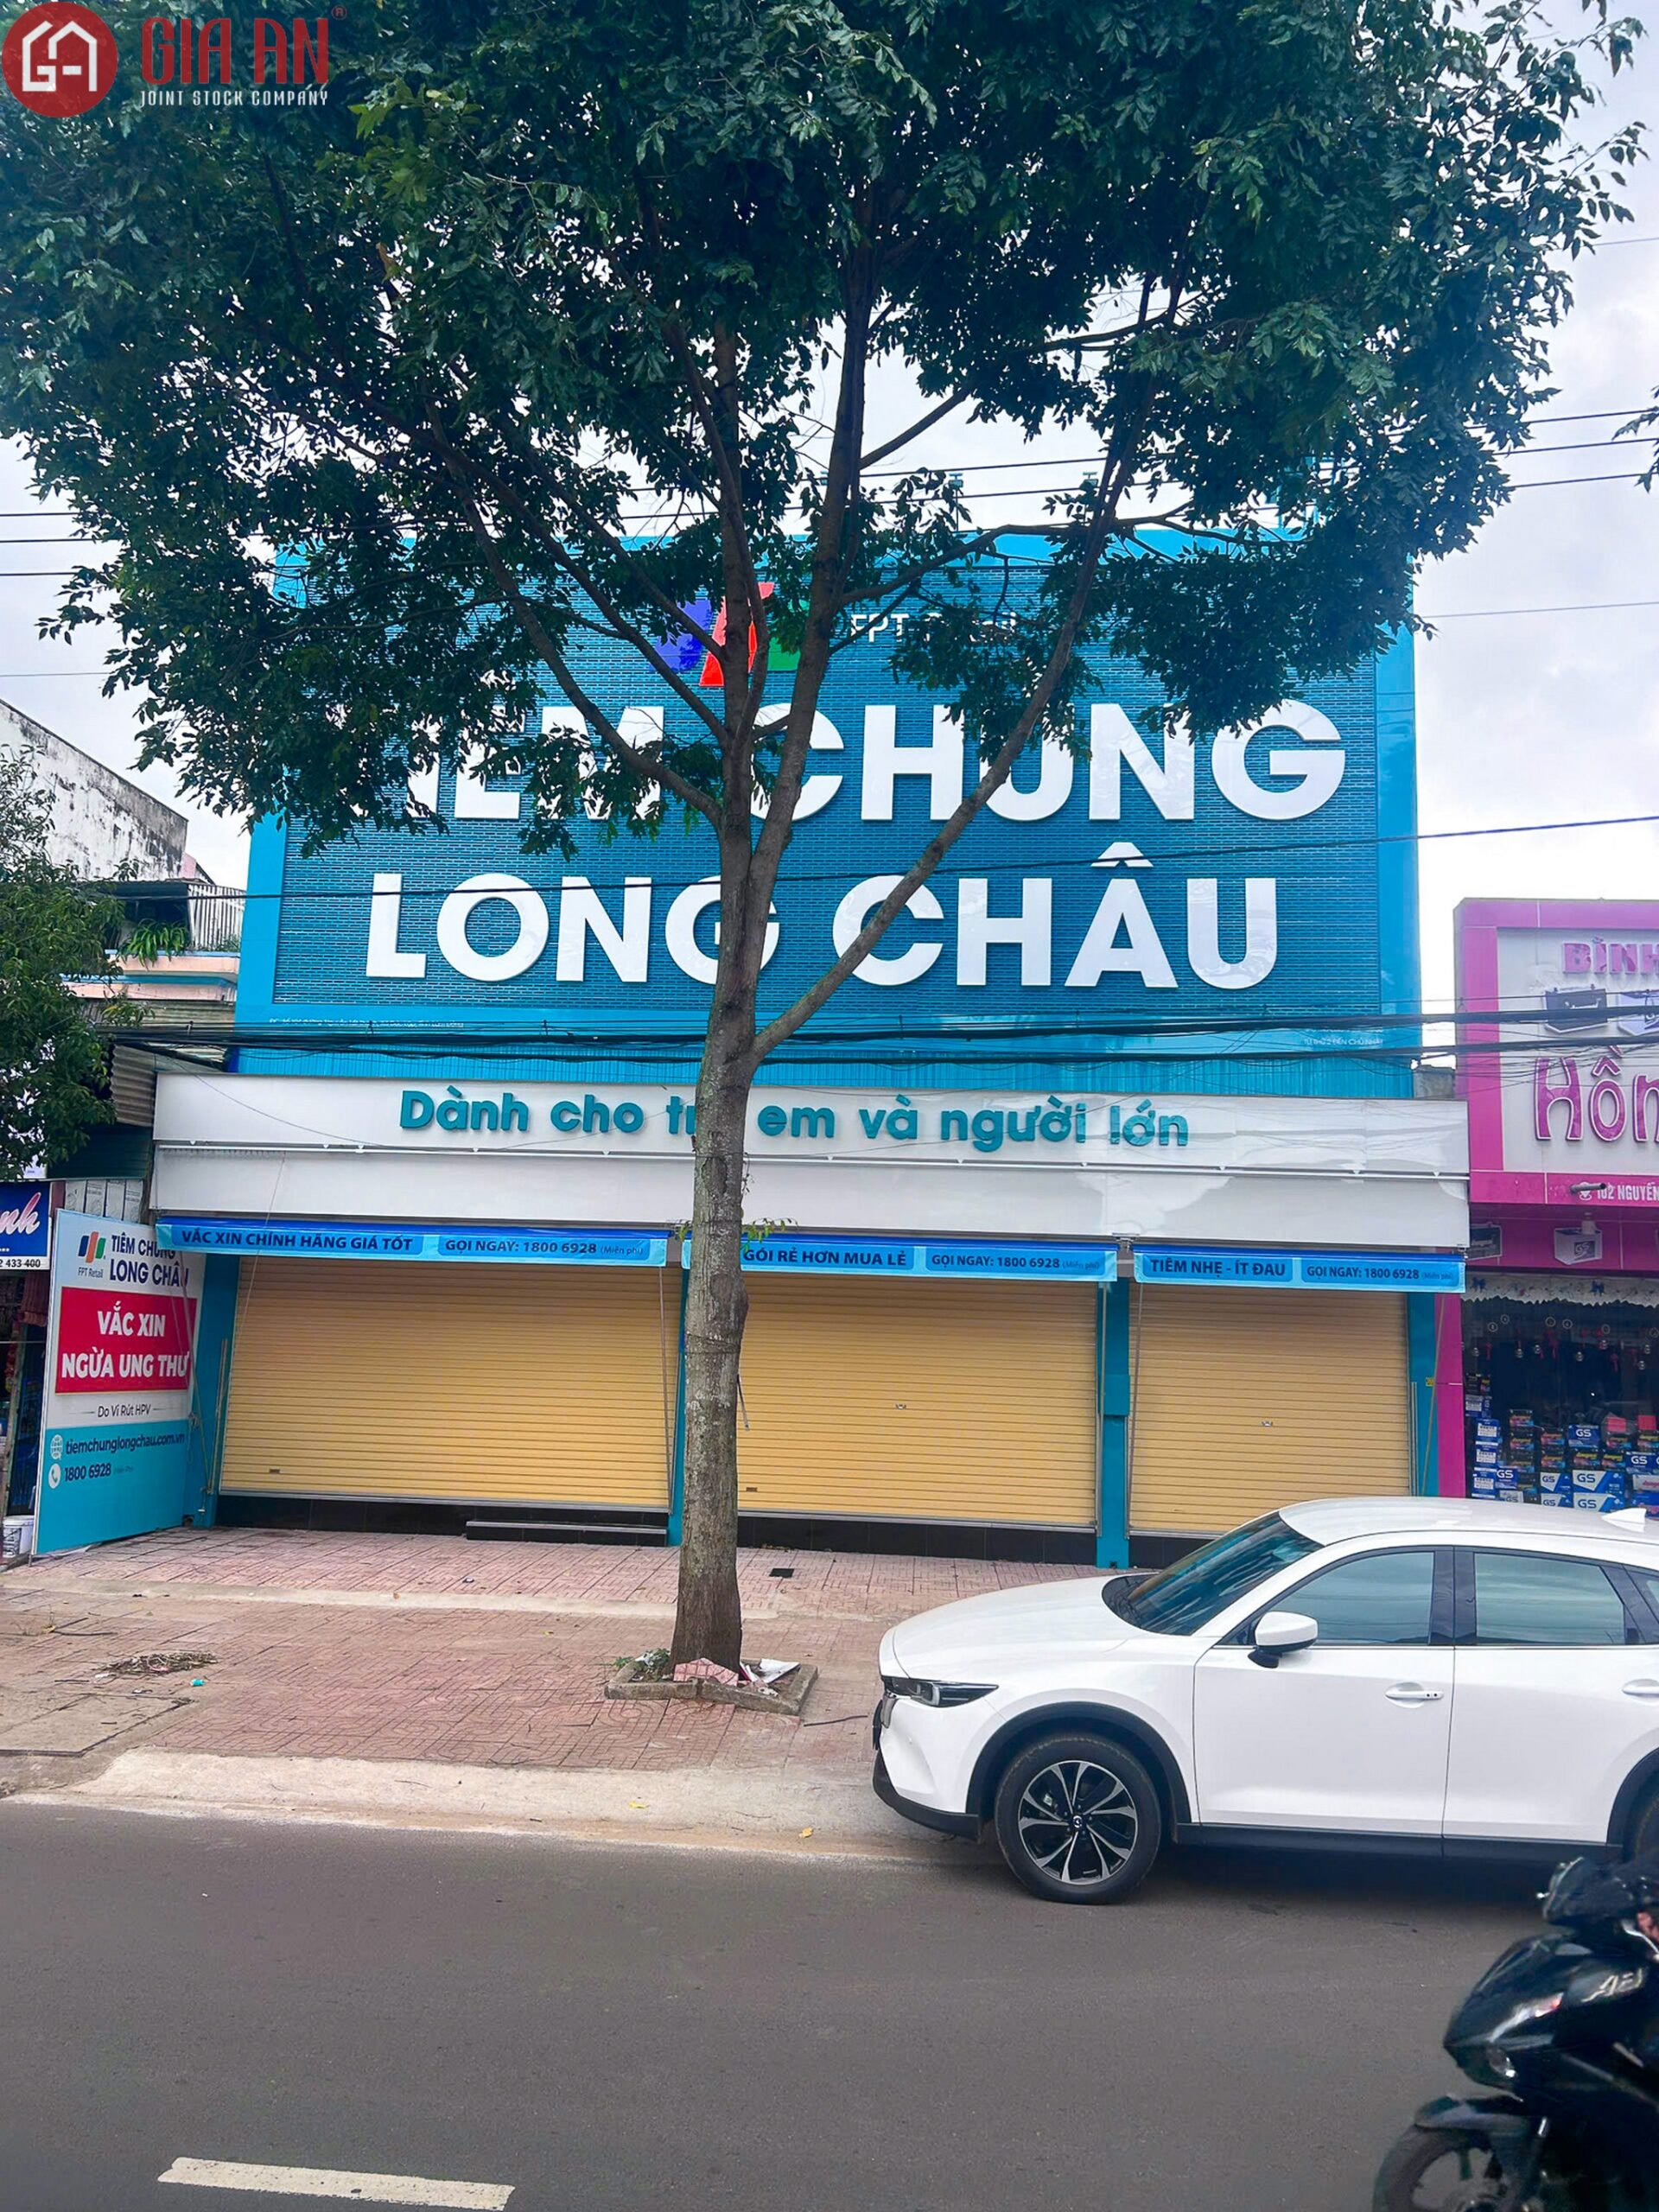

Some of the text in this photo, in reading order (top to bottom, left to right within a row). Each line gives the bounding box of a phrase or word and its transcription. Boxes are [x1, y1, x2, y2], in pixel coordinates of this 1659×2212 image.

[365, 841, 1278, 990] LONG CHÂU
[399, 1085, 530, 1134] Dành
[550, 1093, 645, 1135] cho
[758, 1103, 836, 1139] em
[858, 1094, 919, 1141] và
[941, 1094, 1087, 1154] người
[1109, 1097, 1189, 1147] lớn
[111, 1231, 136, 1255] TIÊM
[181, 1227, 212, 1244] VẮC
[216, 1231, 242, 1245] XIN
[245, 1231, 296, 1247] CHÍNH
[350, 1235, 378, 1250] GIÁ
[382, 1235, 413, 1250] TỐT
[445, 1239, 472, 1254] GỌI
[476, 1240, 518, 1253] NGAY:
[523, 1242, 558, 1253] 1800
[561, 1243, 597, 1254] 6928
[6, 1259, 22, 1268] 433
[743, 1247, 906, 1266] GÓI RẺ HƠN MUA LẺ
[931, 1255, 954, 1268] GỌI
[957, 1255, 994, 1267] NGAY:
[996, 1256, 1027, 1268] 1800
[1030, 1258, 1060, 1268] 6928
[88, 1267, 104, 1278] Retail
[110, 1259, 189, 1287] LONG CHÂU
[1150, 1257, 1189, 1274] TIÊM
[1191, 1261, 1223, 1278] NHẸ
[1235, 1259, 1249, 1275] ÍT
[1253, 1262, 1286, 1276] ĐAU
[1306, 1266, 1328, 1281] GỌI
[1330, 1267, 1362, 1279] NGAY:
[1363, 1268, 1391, 1279] 1800
[1393, 1268, 1420, 1280] 6928
[97, 1300, 166, 1337] VẮC XIN
[61, 1346, 190, 1378] NGỪA UNG THƯ
[98, 1405, 110, 1417] Do
[136, 1403, 151, 1416] HPV
[1575, 1428, 1592, 1438] GS
[66, 1433, 186, 1455] tiemchunglongchau.com.vn
[1630, 1455, 1649, 1465] GS
[64, 1465, 86, 1482] 1800
[88, 1463, 111, 1478] 6928
[1497, 1470, 1514, 1478] GS
[1577, 1473, 1596, 1483] GS
[1578, 1499, 1597, 1509] GS
